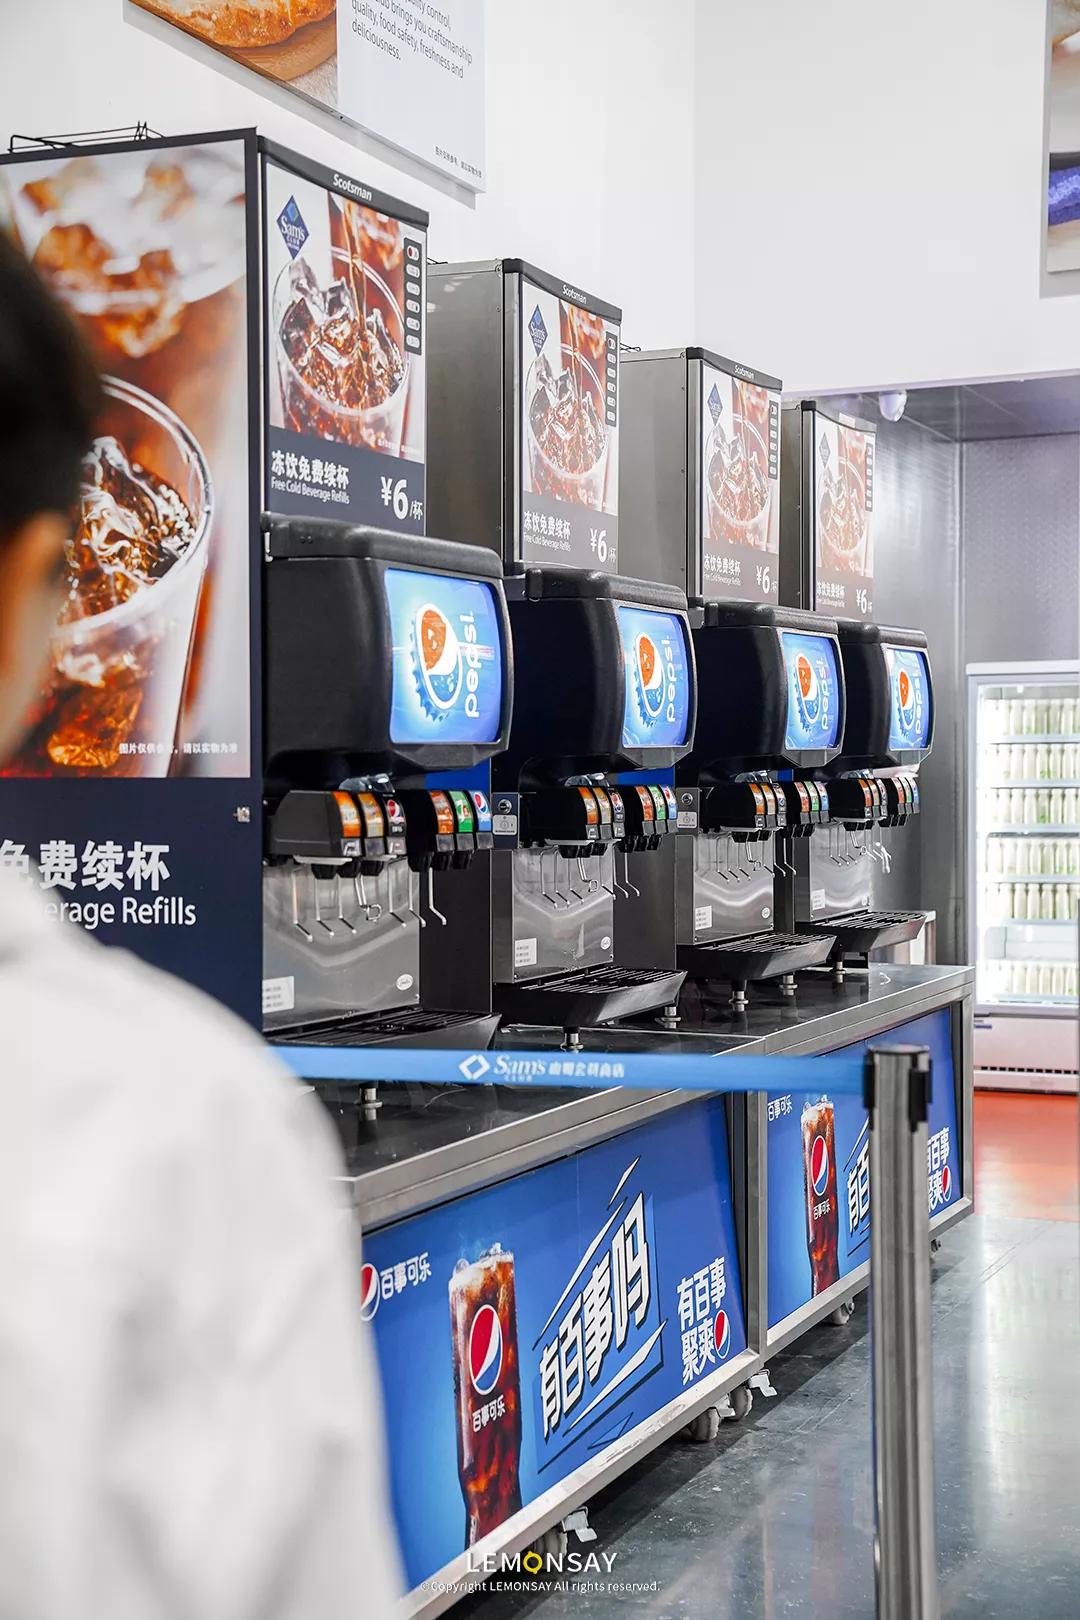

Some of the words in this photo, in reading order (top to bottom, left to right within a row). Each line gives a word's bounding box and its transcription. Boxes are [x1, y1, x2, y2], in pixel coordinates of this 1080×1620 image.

[352, 18, 401, 60] deliciousness.
[391, 2, 413, 26] brings
[414, 17, 427, 34] you
[427, 26, 472, 65] craftsmanship
[427, 5, 451, 31] control,
[380, 12, 396, 35] food
[419, 38, 450, 70] freshness
[451, 63, 464, 78] and
[333, 173, 372, 200] Scotsman
[562, 284, 587, 304] Scotsman
[271, 450, 349, 490] 冻饮免费续杯
[271, 476, 286, 491] Free
[286, 480, 301, 494] Cold
[302, 483, 330, 502] Beverage
[331, 489, 350, 504] Refills
[459, 609, 482, 718] pepsi
[661, 634, 676, 723] pepsi
[816, 657, 830, 730] pepsi
[122, 896, 196, 926] Refills
[767, 1094, 793, 1122] 百事可乐
[813, 1198, 831, 1221] 百事可乐
[380, 1252, 432, 1300] 百事可乐
[677, 1256, 726, 1332] 有百事
[540, 1191, 650, 1439] 有百事吗
[681, 1317, 716, 1386] 聚爽
[472, 1394, 505, 1432] 百事可乐
